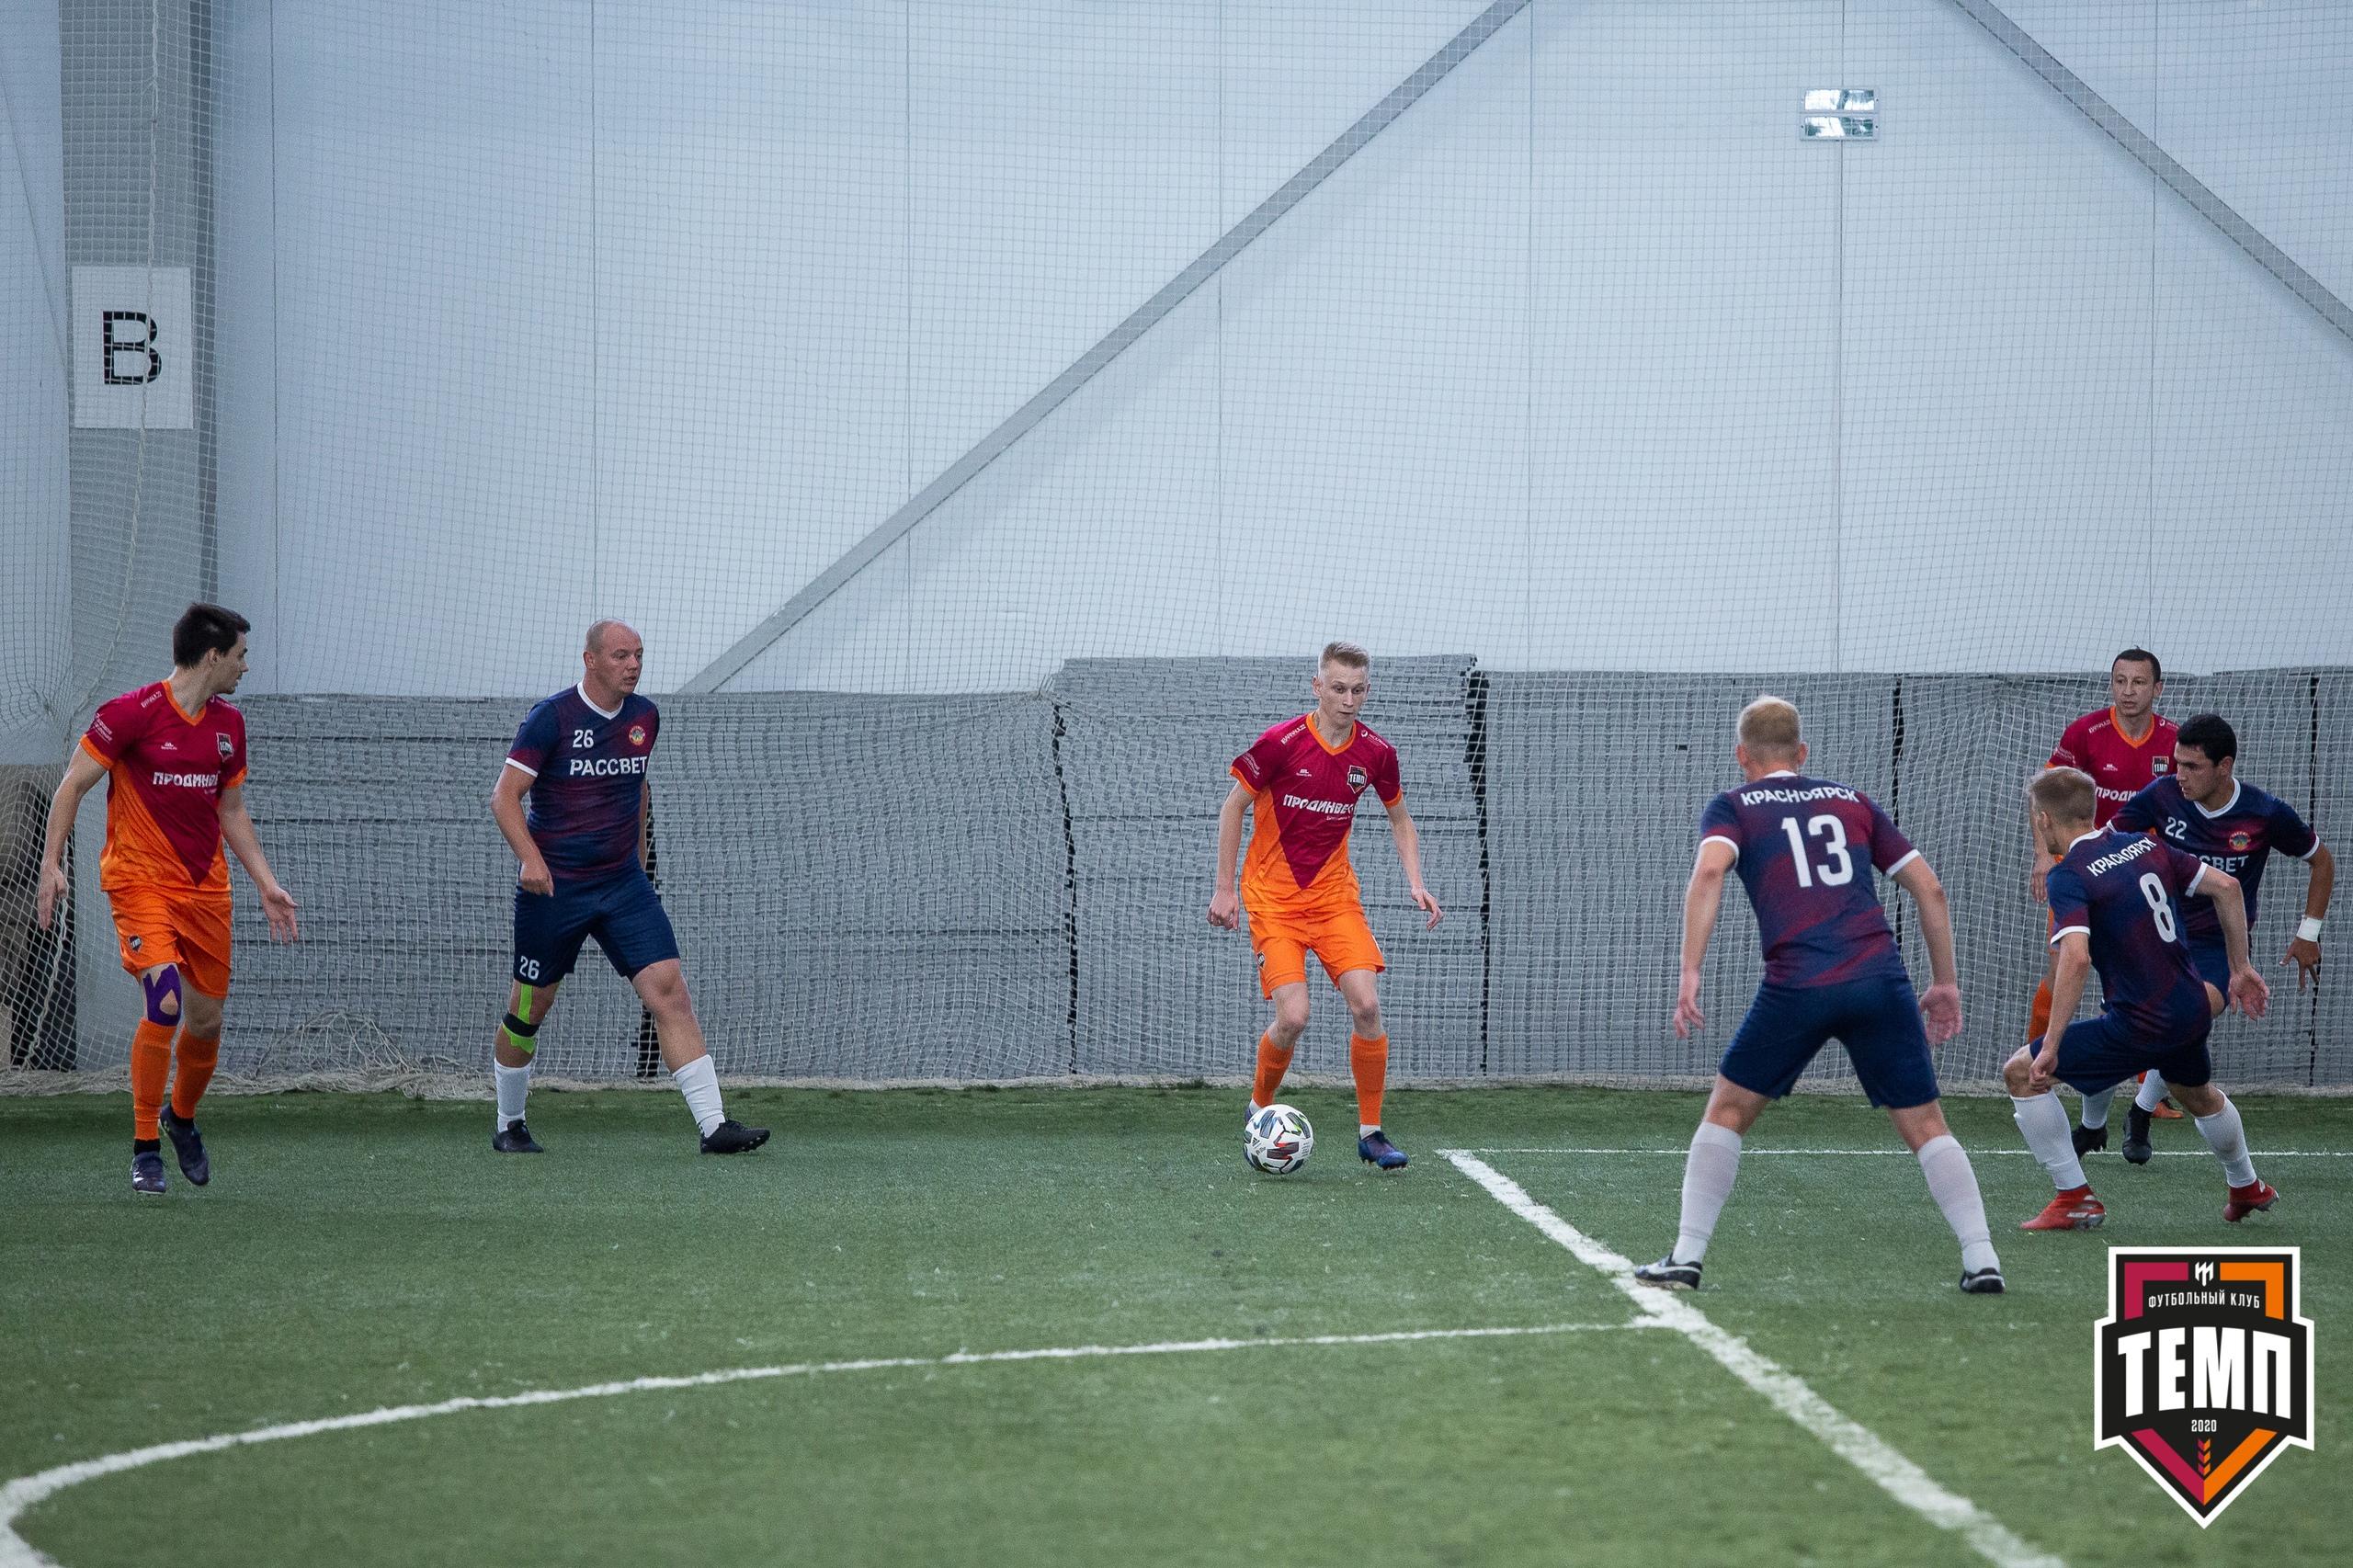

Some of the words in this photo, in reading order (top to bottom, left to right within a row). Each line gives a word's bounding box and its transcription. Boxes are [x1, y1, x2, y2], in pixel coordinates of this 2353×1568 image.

[572, 729, 595, 748] 26
[569, 756, 647, 776] РАССВЕТ
[1741, 786, 1860, 806] КРАСНОЯРСК
[2165, 816, 2188, 840] 22
[1780, 813, 1854, 888] 13
[2086, 836, 2157, 877] КРАСНОЯРСК
[2139, 872, 2177, 943] 8
[519, 955, 540, 981] 26
